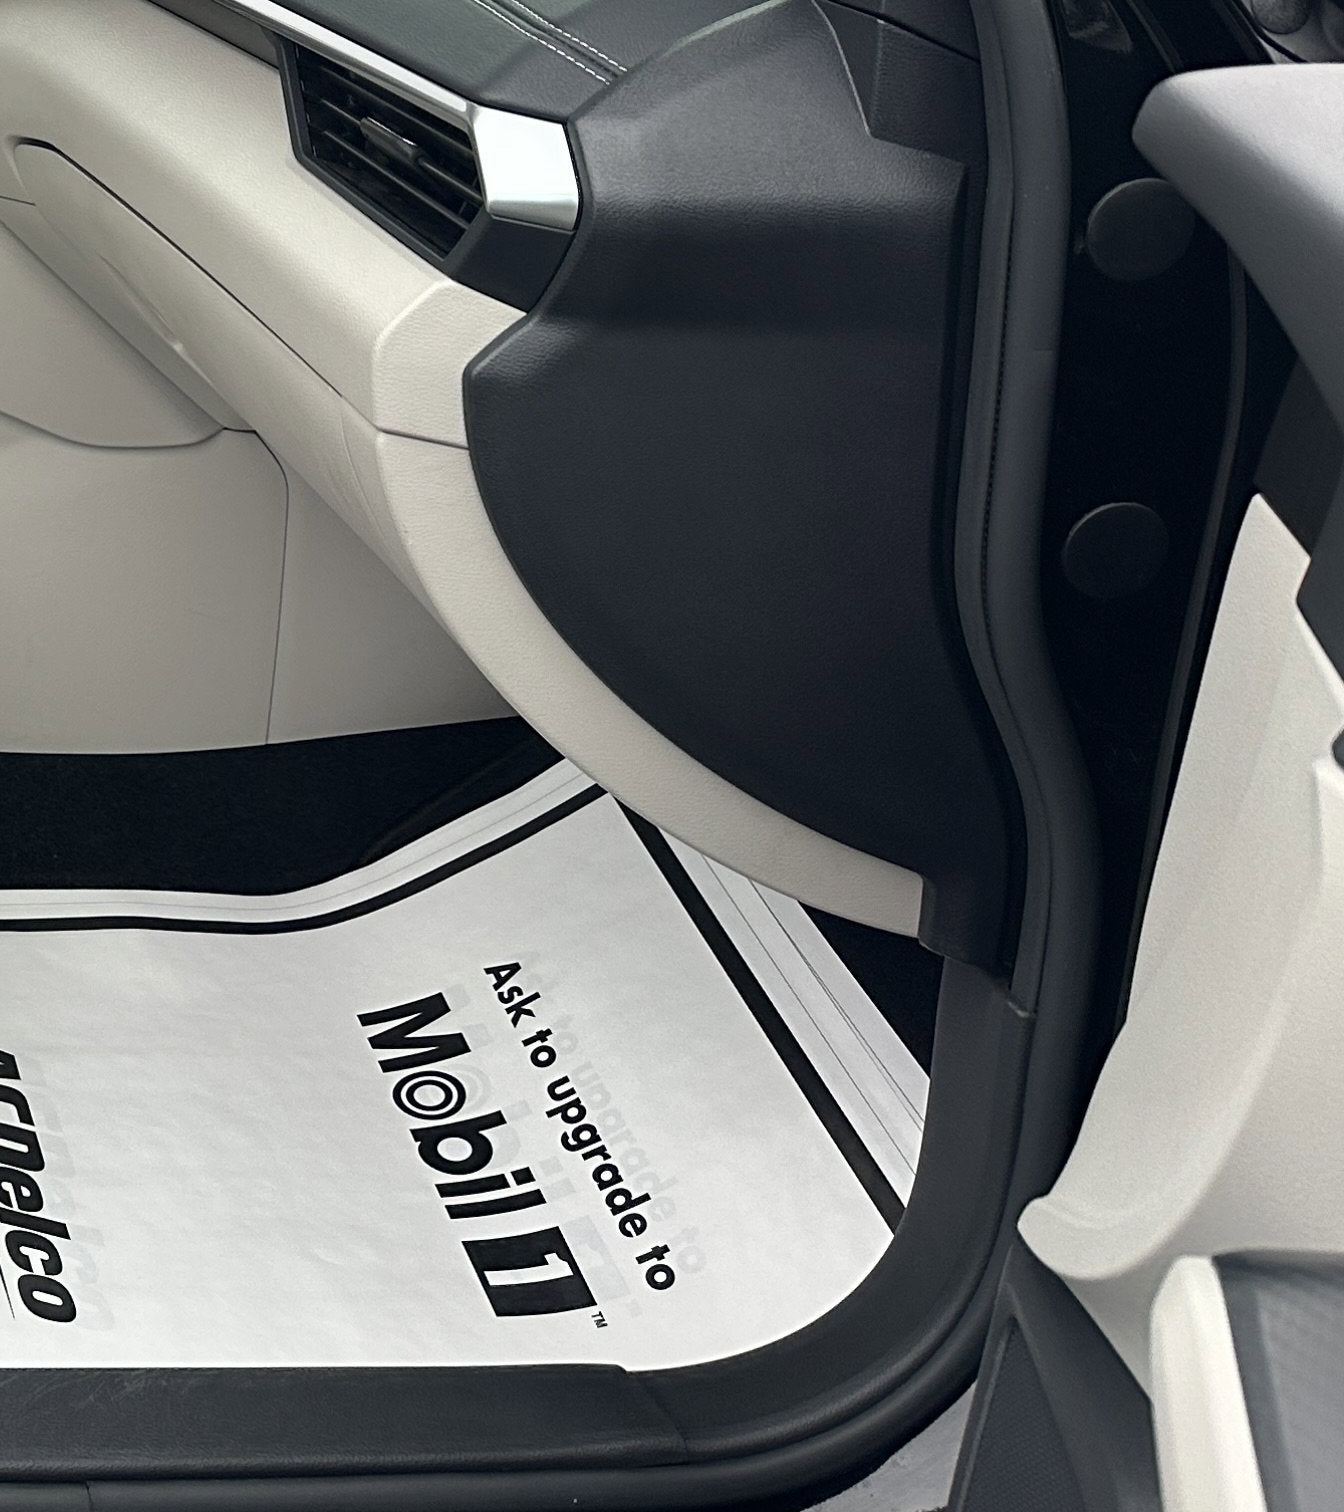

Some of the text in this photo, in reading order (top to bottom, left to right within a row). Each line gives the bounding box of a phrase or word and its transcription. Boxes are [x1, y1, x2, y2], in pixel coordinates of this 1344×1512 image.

[356, 991, 548, 1220] Mobil
[483, 961, 676, 1291] Ask to upgrade to
